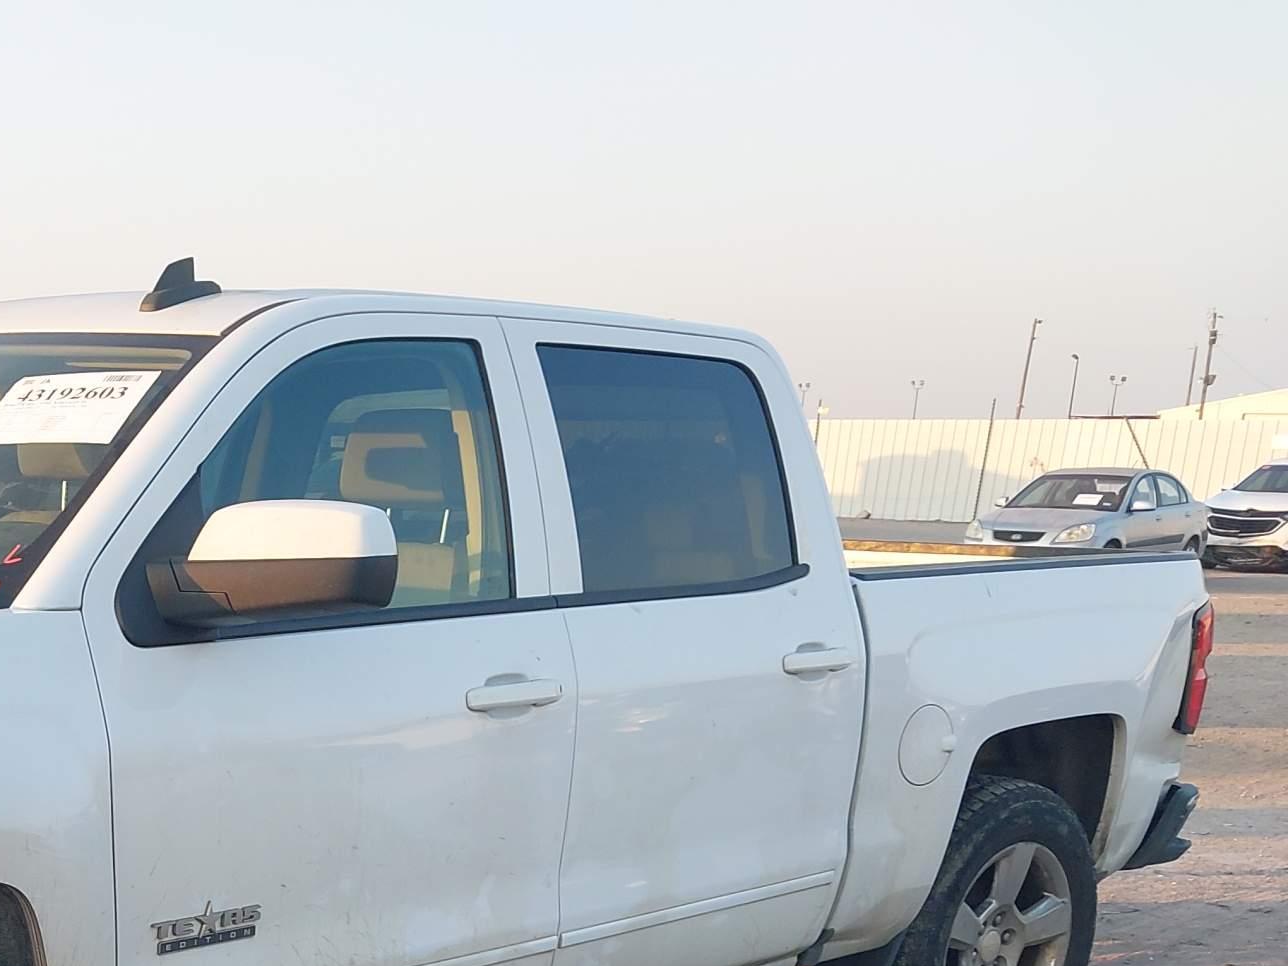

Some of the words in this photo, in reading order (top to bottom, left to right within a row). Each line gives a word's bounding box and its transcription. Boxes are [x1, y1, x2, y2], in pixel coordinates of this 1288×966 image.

[17, 385, 129, 402] 43192603
[150, 901, 262, 940] TEXAS
[165, 928, 251, 952] EDITION
